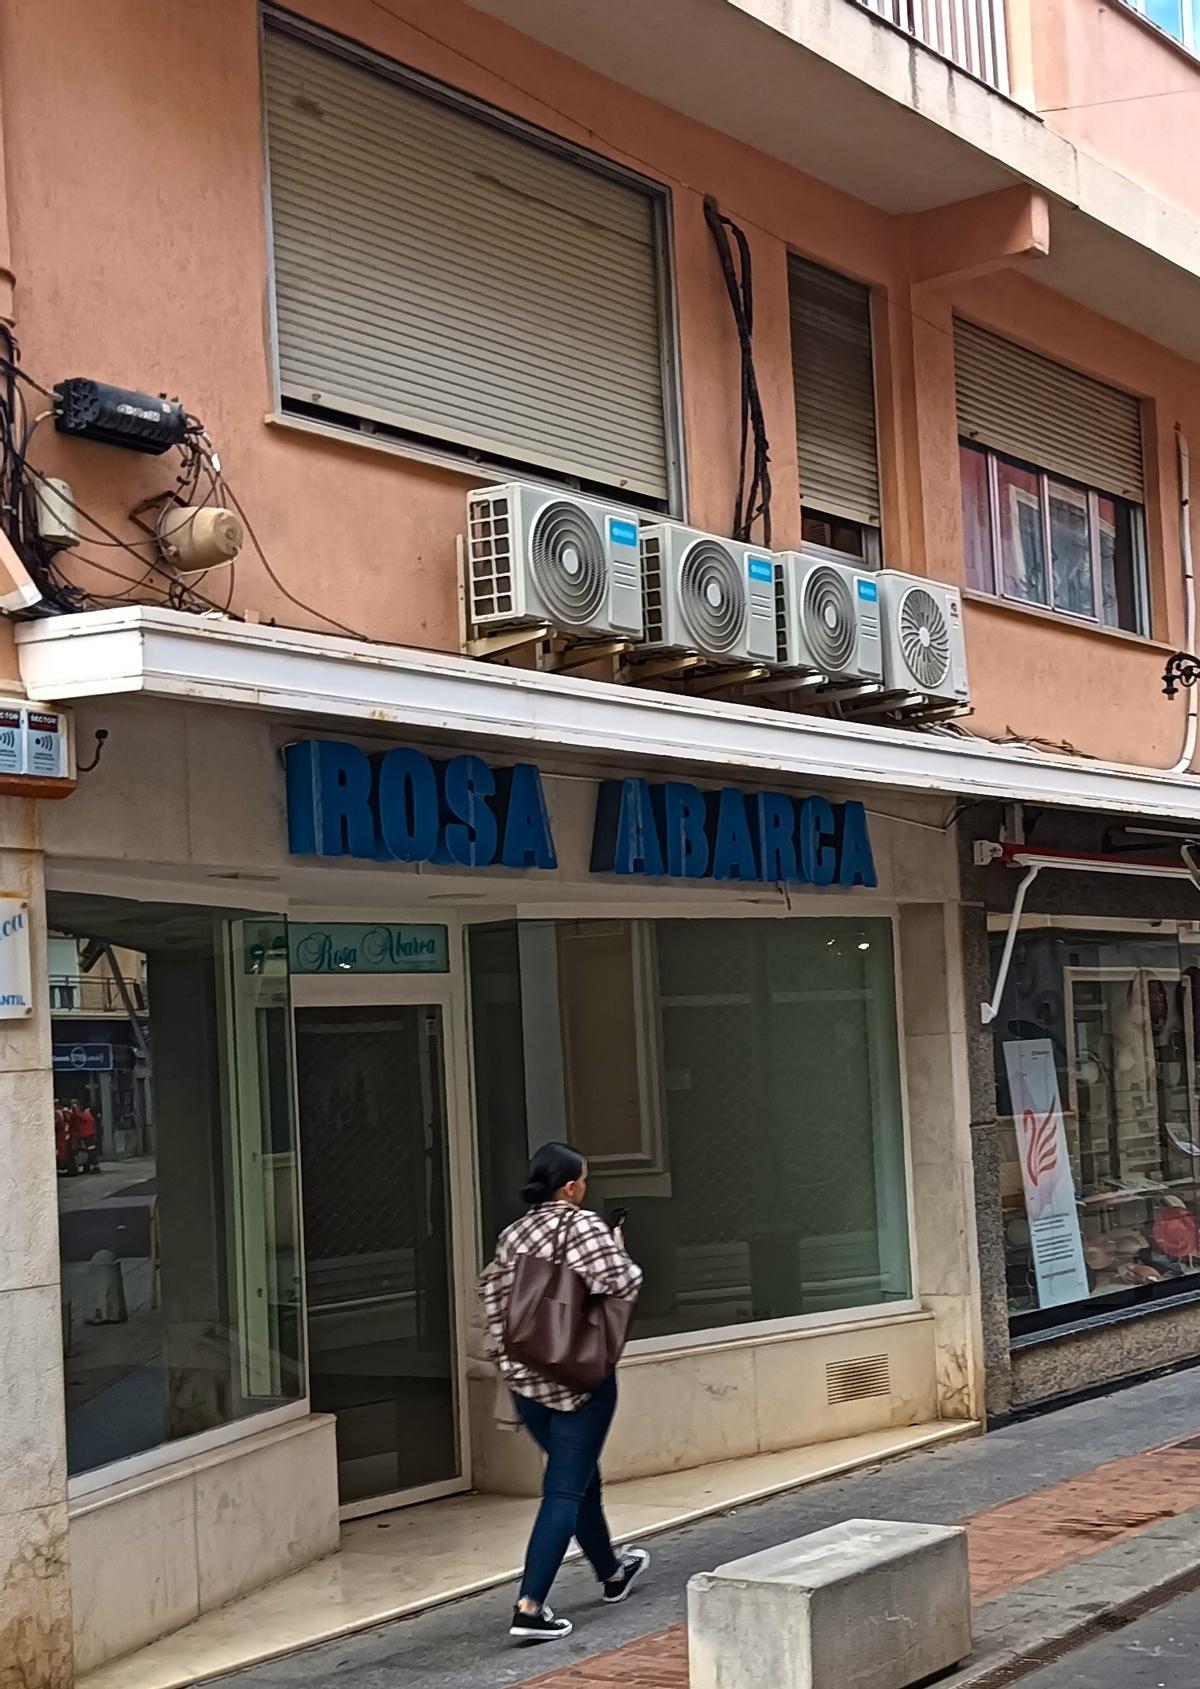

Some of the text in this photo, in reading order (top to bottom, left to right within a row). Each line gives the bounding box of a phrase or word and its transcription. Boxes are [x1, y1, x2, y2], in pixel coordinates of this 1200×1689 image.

[290, 740, 878, 887] ROSA ABARCA
[297, 926, 436, 971] Rosa Abarca
